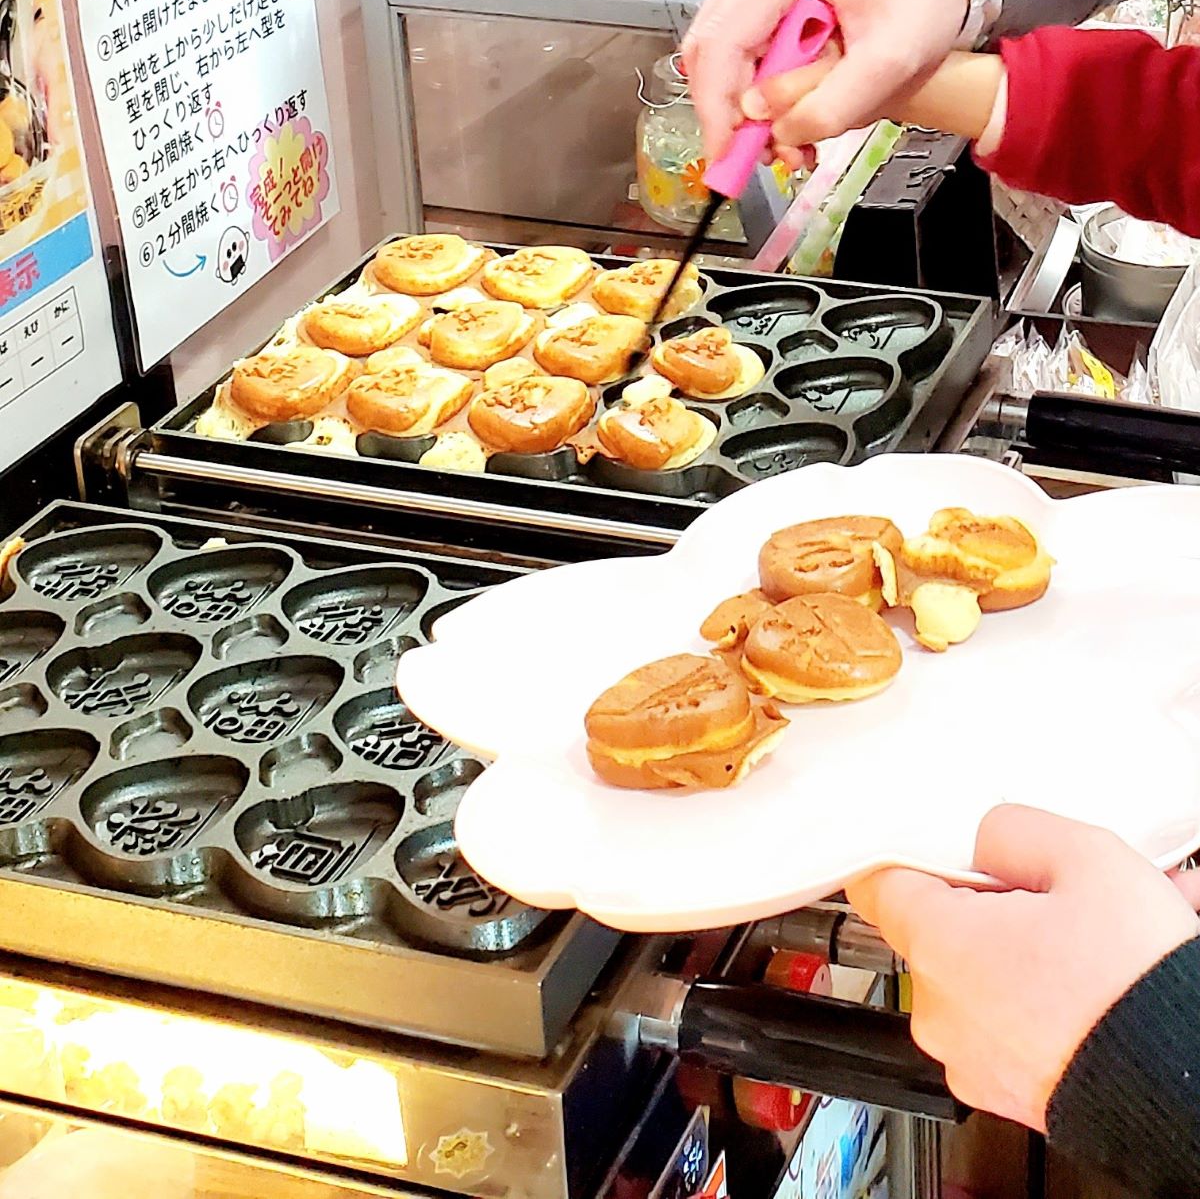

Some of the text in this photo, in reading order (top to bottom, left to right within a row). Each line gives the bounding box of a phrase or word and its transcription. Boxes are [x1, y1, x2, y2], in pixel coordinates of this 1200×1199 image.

[132, 81, 213, 151] ひっくり返す
